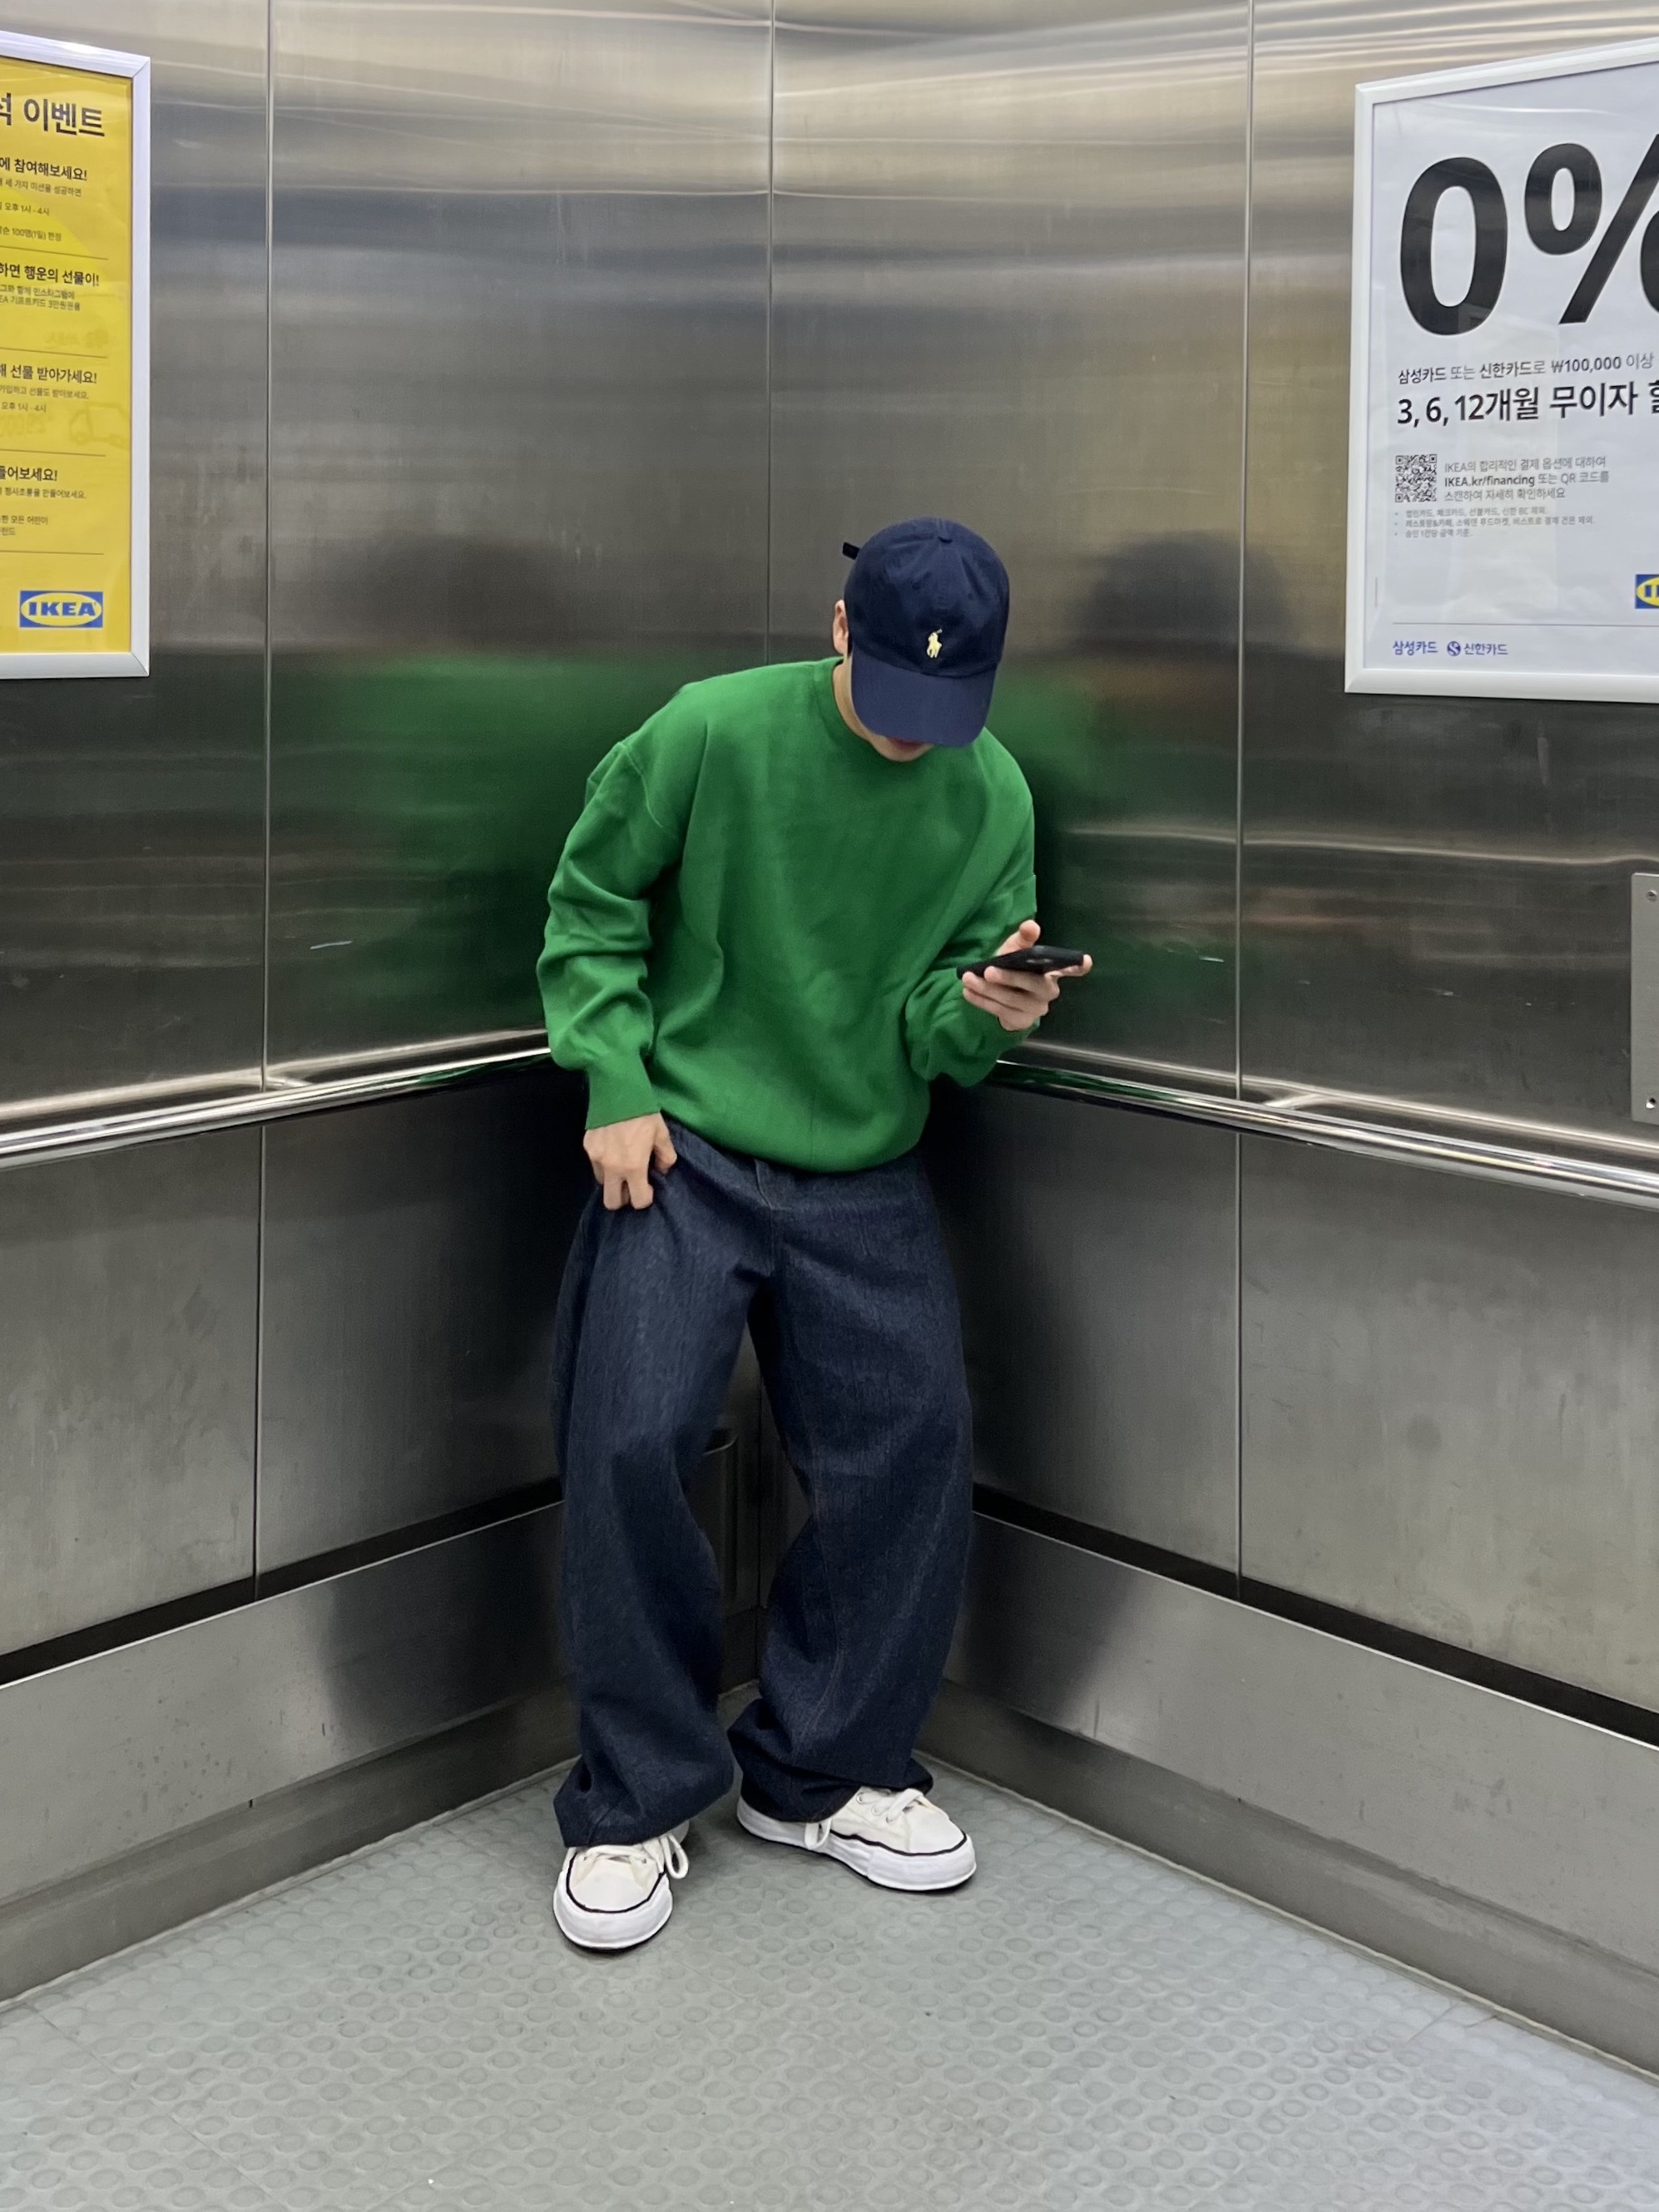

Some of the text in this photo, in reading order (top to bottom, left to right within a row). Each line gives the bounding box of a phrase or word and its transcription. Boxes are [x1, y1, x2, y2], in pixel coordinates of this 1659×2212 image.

[23, 99, 105, 136] 이벤트
[14, 158, 87, 181] 참여해보세요!
[1399, 130, 1659, 336] 0%
[24, 265, 58, 284] 행운의
[62, 270, 100, 287] 선물이!
[11, 364, 33, 379] 선물
[37, 366, 97, 384] 받아가세요!
[1398, 366, 1447, 385] 삼성카드
[1449, 365, 1476, 380] 또는
[1478, 359, 1546, 379] 신한카드로
[1626, 351, 1656, 371] 이상
[1549, 380, 1639, 419] 무이자
[1574, 455, 1607, 468] 대하여
[1444, 475, 1536, 487] IKEA.kr/financing
[1538, 473, 1558, 485] 또는
[1560, 473, 1577, 485] QR
[1485, 488, 1514, 501] 자세히
[1517, 487, 1566, 501] 확인하세요
[28, 601, 96, 616] IKEA
[1393, 641, 1508, 656] 삼성카드 신한카드
